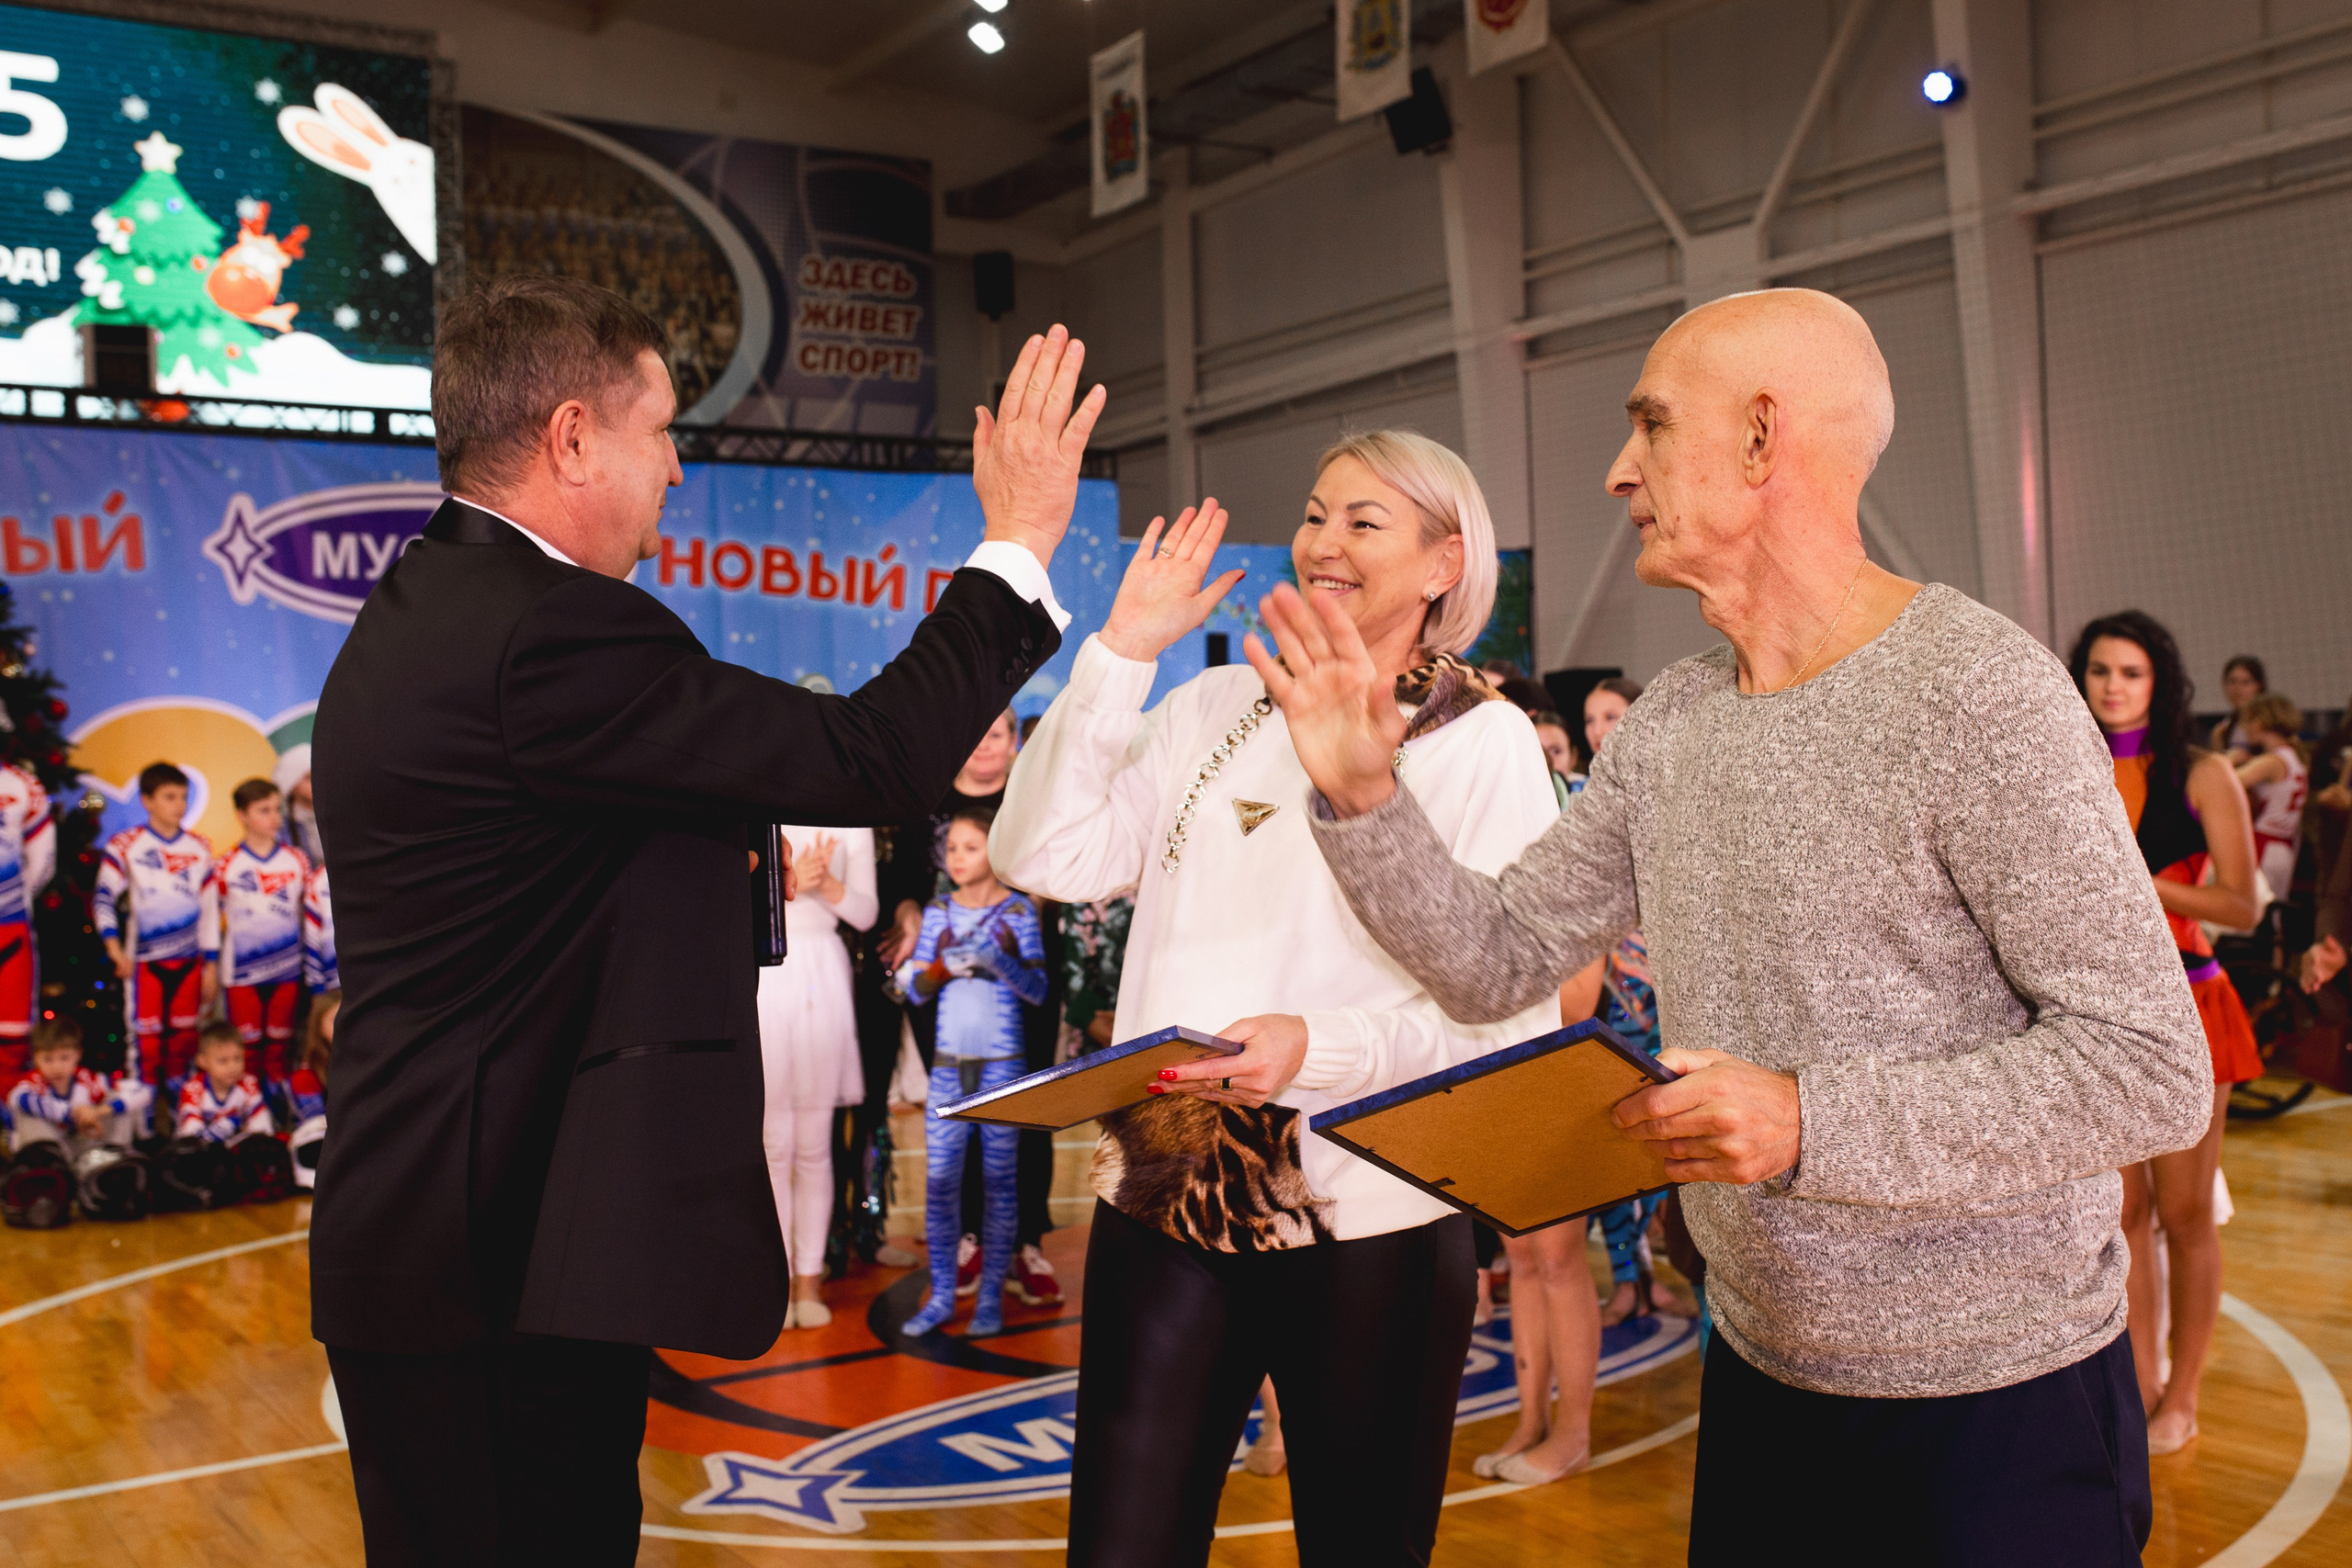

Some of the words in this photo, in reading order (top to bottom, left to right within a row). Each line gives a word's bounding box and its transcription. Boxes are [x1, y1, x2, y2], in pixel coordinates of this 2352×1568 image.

[801, 256, 915, 295] ЗДЕСЬ
[799, 300, 919, 336] ЖИВЕТ
[798, 343, 920, 378] СПОРТ!
[311, 530, 424, 581] МУ
[658, 536, 907, 613] НОВЫЙ
